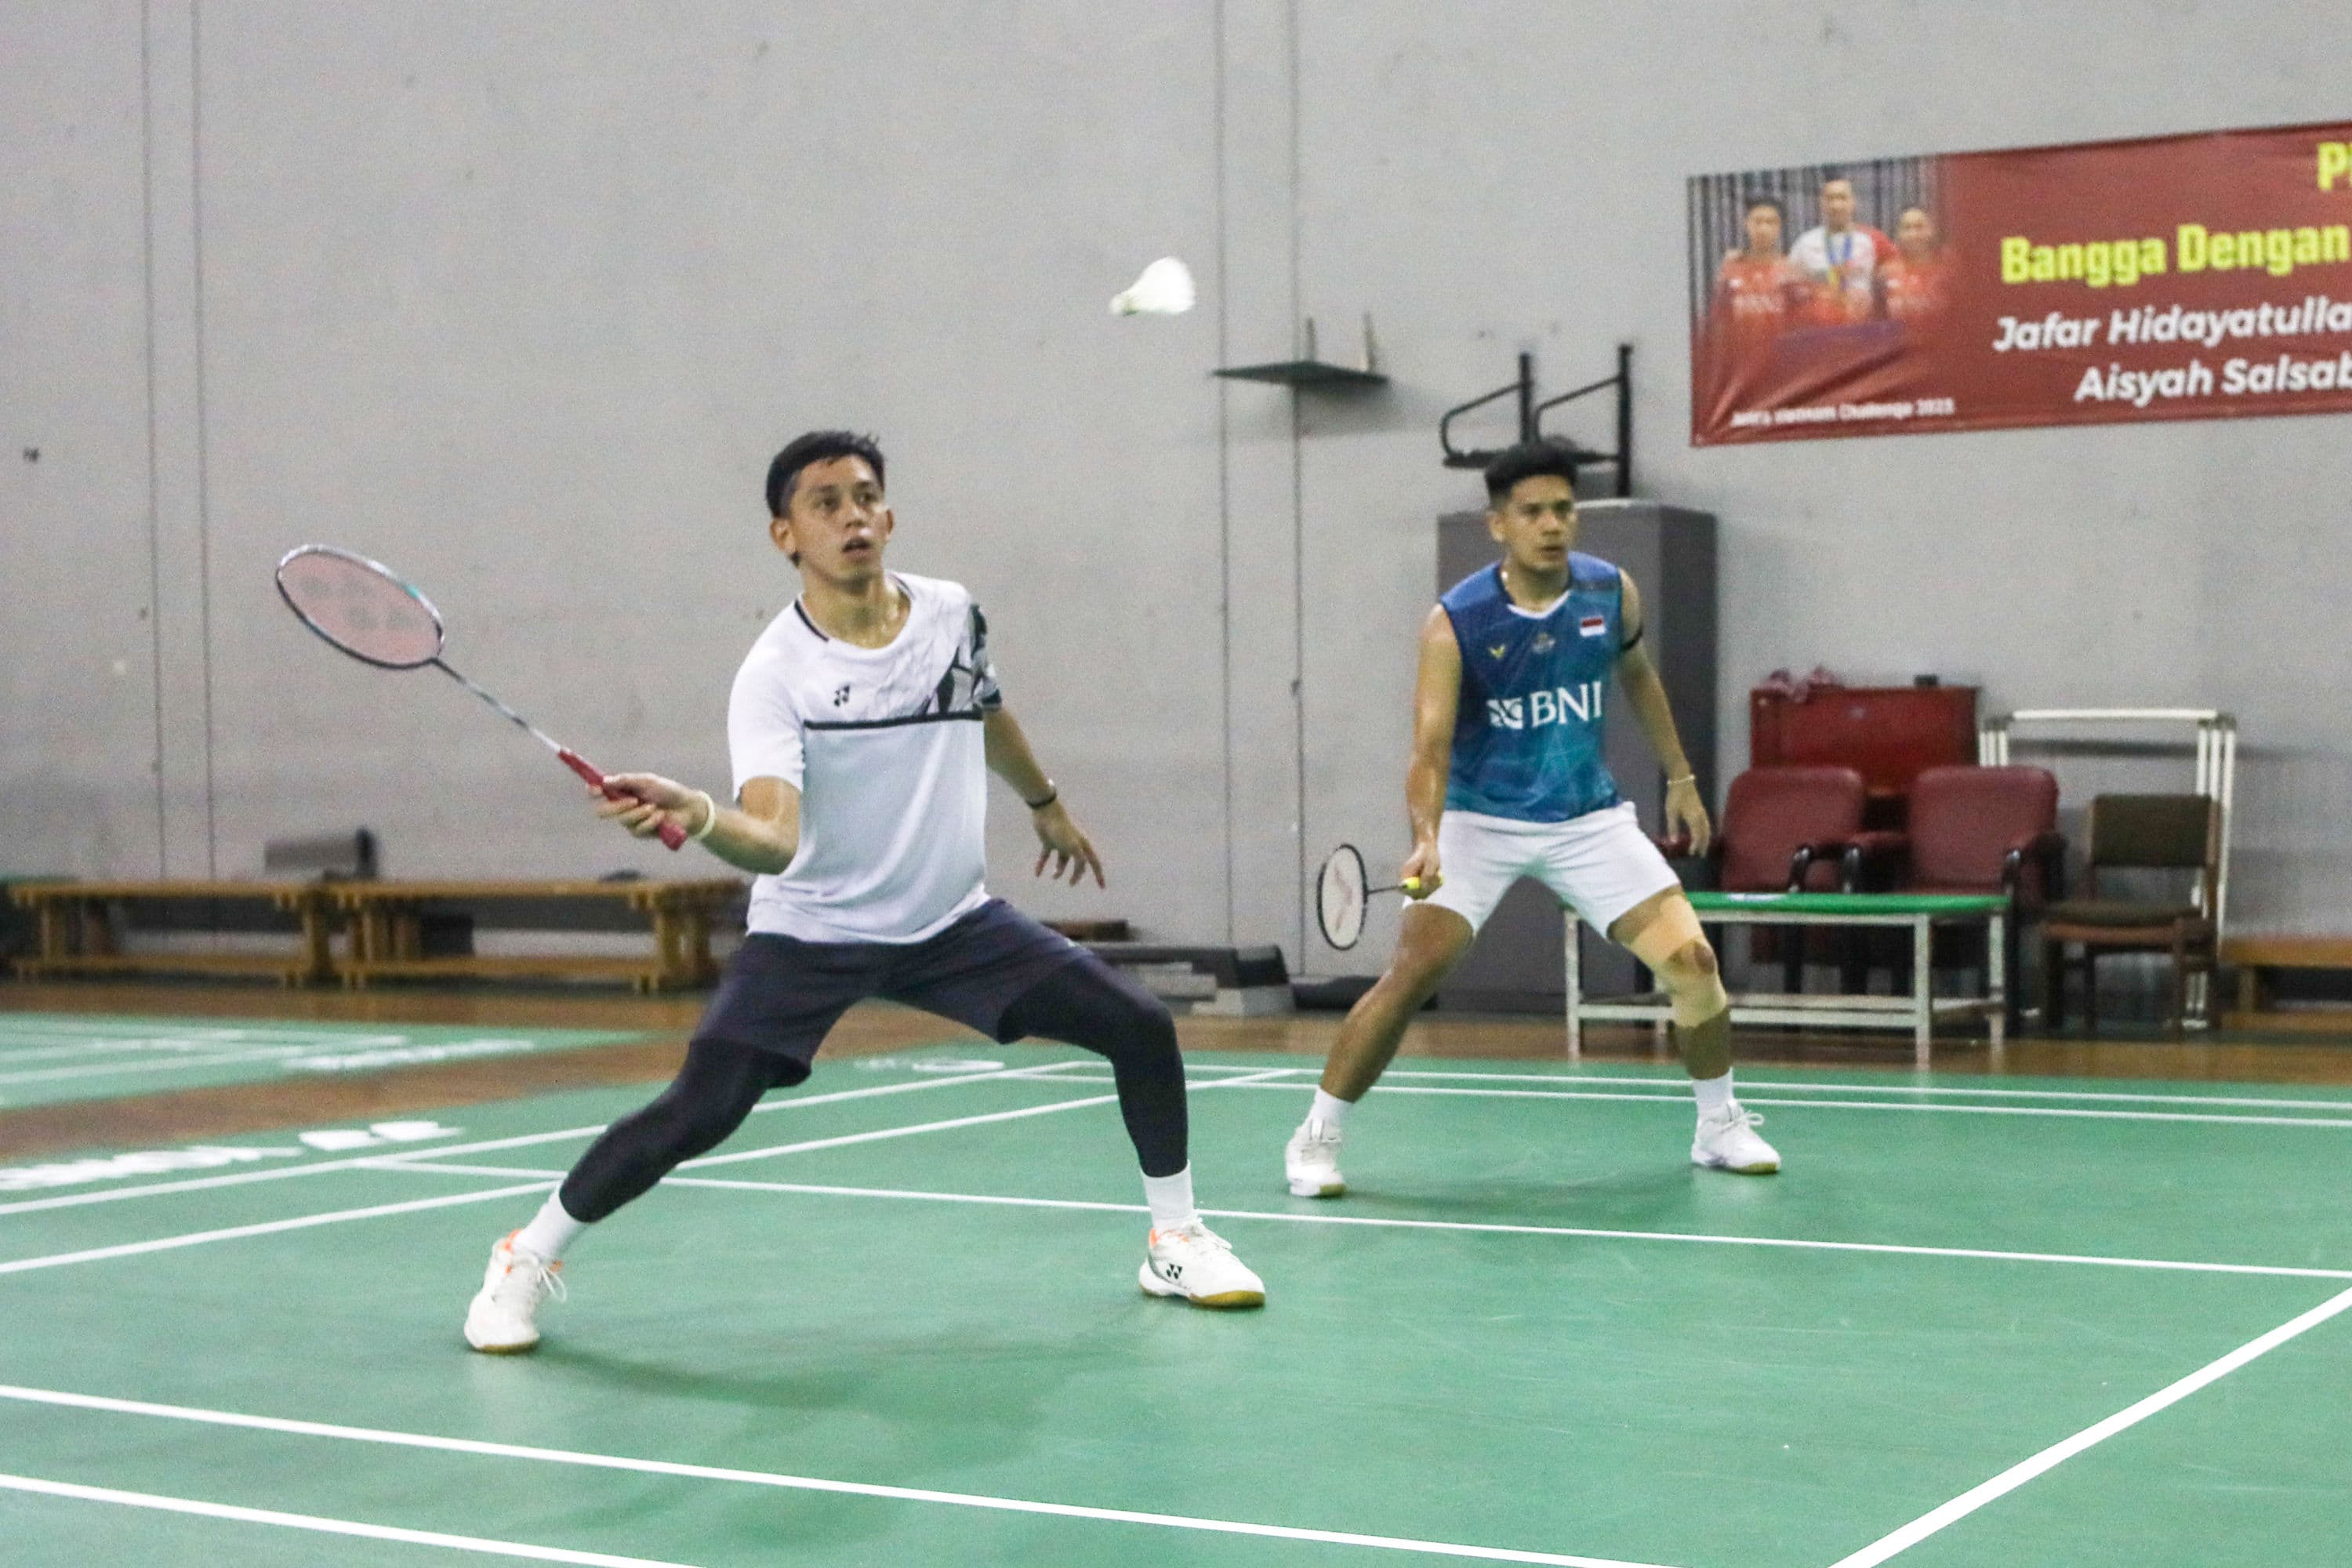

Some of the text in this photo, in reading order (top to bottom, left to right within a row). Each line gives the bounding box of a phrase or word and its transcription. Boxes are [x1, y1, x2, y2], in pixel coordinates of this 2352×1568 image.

[2317, 141, 2352, 191] P
[2001, 223, 2350, 287] Bangga Dengan
[1992, 311, 2103, 352] Jafar
[2073, 358, 2212, 408] Aisyah
[1530, 681, 1602, 728] BNI
